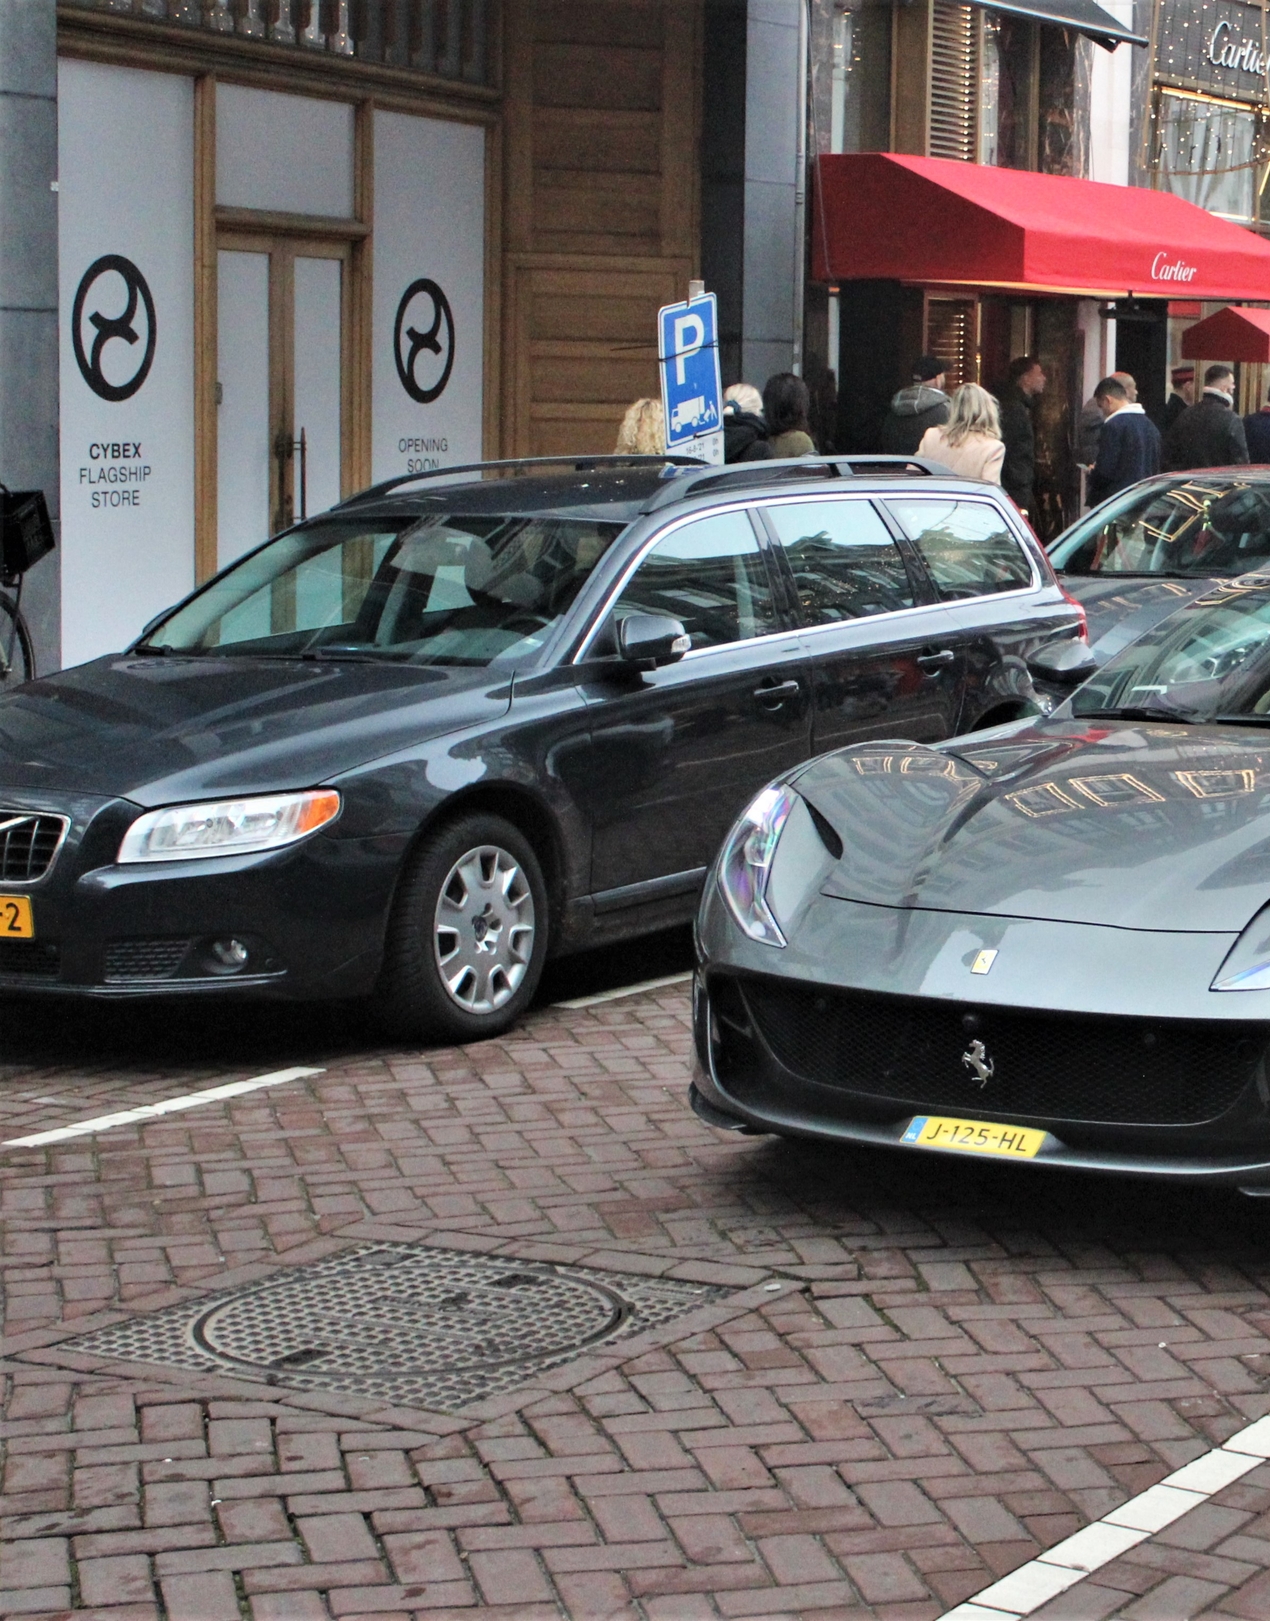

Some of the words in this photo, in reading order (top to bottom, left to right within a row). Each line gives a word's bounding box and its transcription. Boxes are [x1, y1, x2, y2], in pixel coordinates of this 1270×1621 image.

[1151, 251, 1197, 282] Cartier
[674, 313, 705, 385] P
[89, 442, 142, 460] CYBEX
[399, 438, 448, 452] OPENING
[407, 458, 440, 473] SOON
[79, 466, 152, 484] FLAGSHIP
[91, 490, 140, 508] STORE
[905, 1132, 918, 1141] NL
[926, 1123, 1028, 1152] J-125-HL
